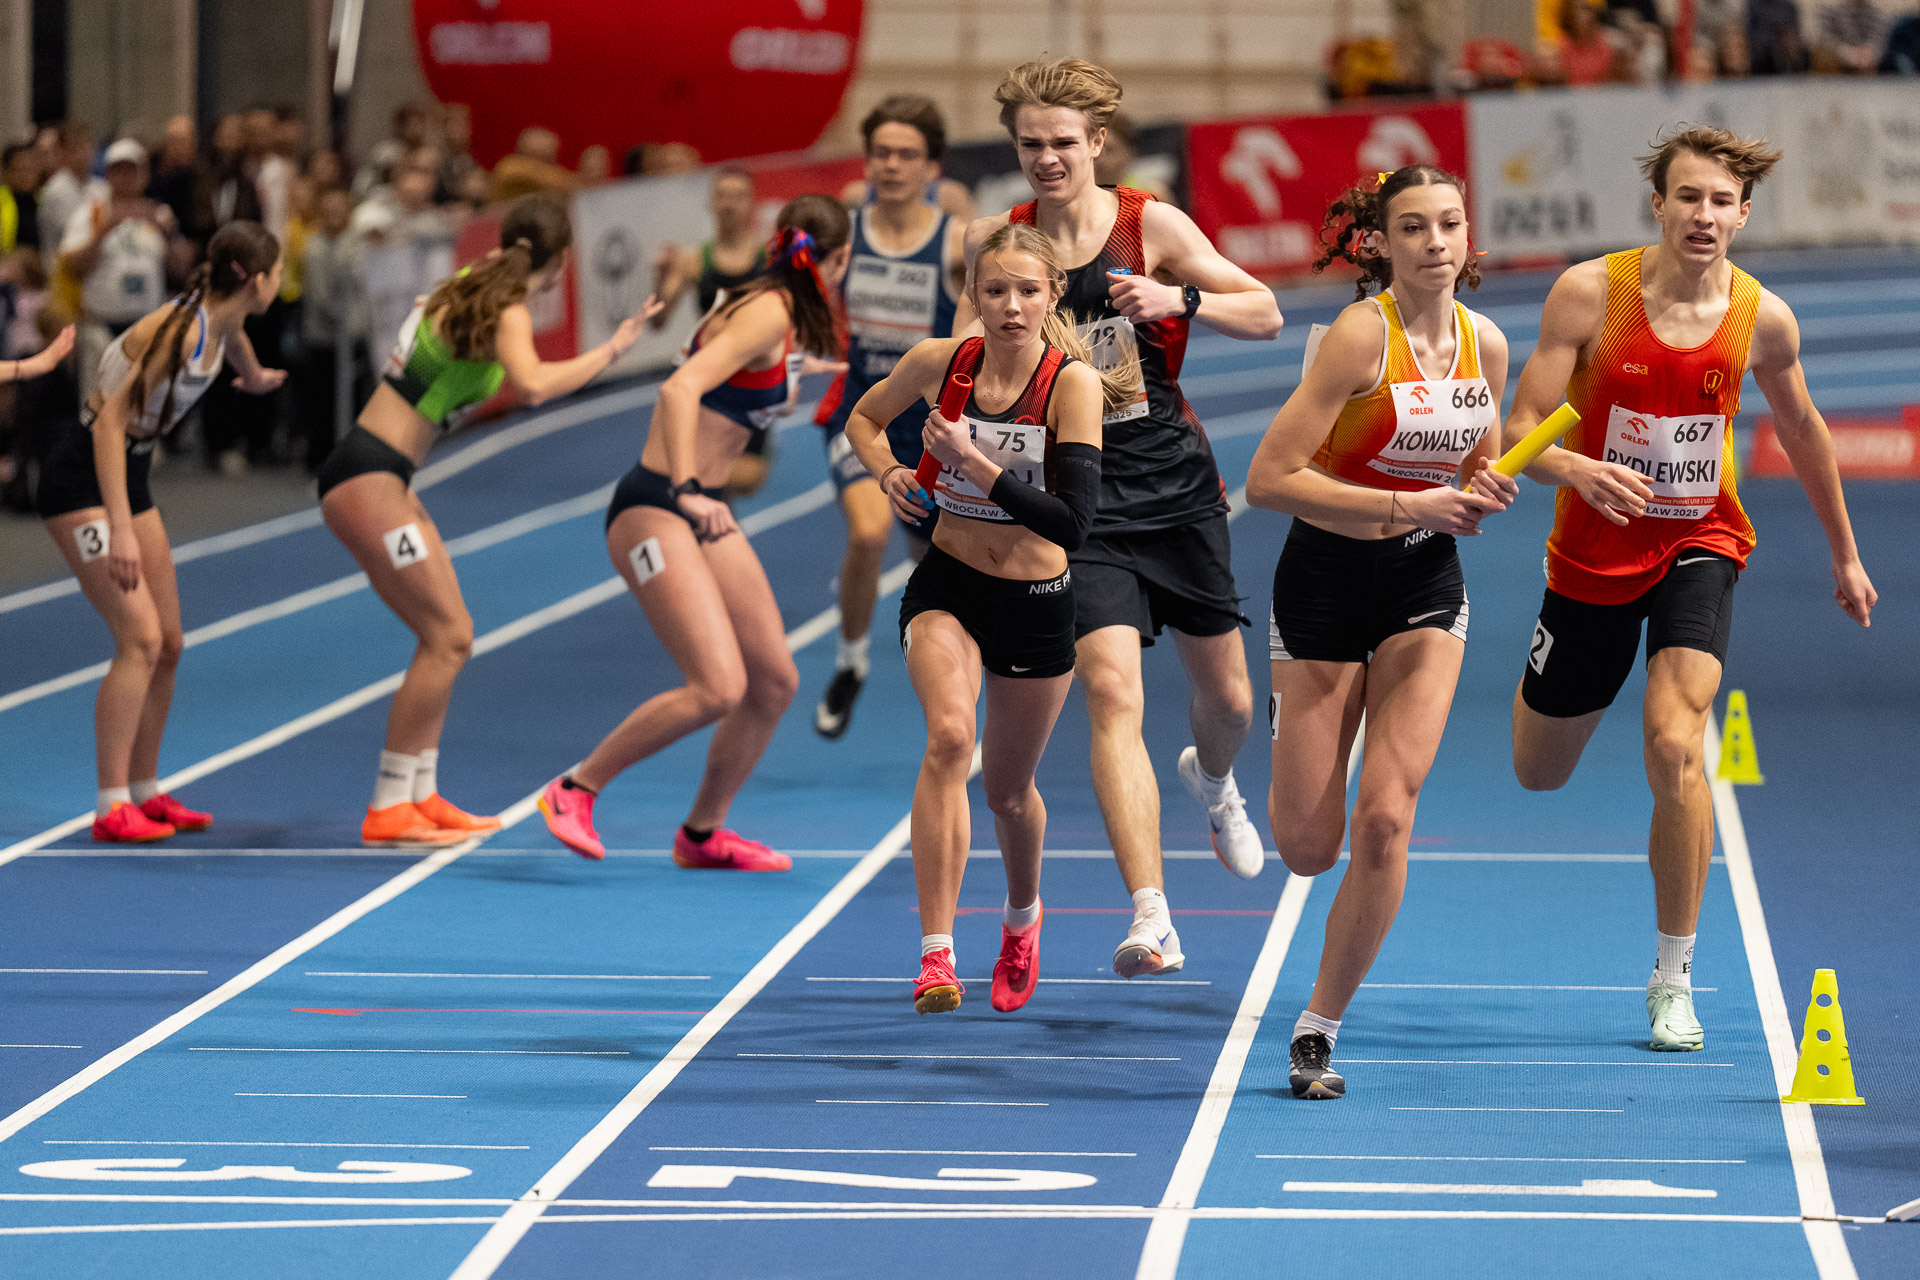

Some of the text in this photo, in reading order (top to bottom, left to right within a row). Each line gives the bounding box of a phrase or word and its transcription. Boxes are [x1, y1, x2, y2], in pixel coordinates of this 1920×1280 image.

[1451, 386, 1489, 409] 666
[1409, 407, 1434, 415] ORLEN
[996, 430, 1026, 453] 75
[1620, 432, 1650, 447] ORLEN
[1673, 422, 1714, 444] 667
[1386, 467, 1443, 481] WROCŁAW
[944, 499, 999, 517] WROCŁAW
[1672, 509, 1699, 517] 2025
[83, 526, 102, 555] 3
[397, 532, 417, 558] 4
[1404, 527, 1435, 548] NIKE
[638, 546, 654, 574] 1
[1028, 579, 1062, 595] NIKE
[1530, 627, 1546, 667] 2
[18, 1157, 473, 1184] 3
[646, 1164, 1098, 1191] 2
[1282, 1178, 1718, 1198] 1
